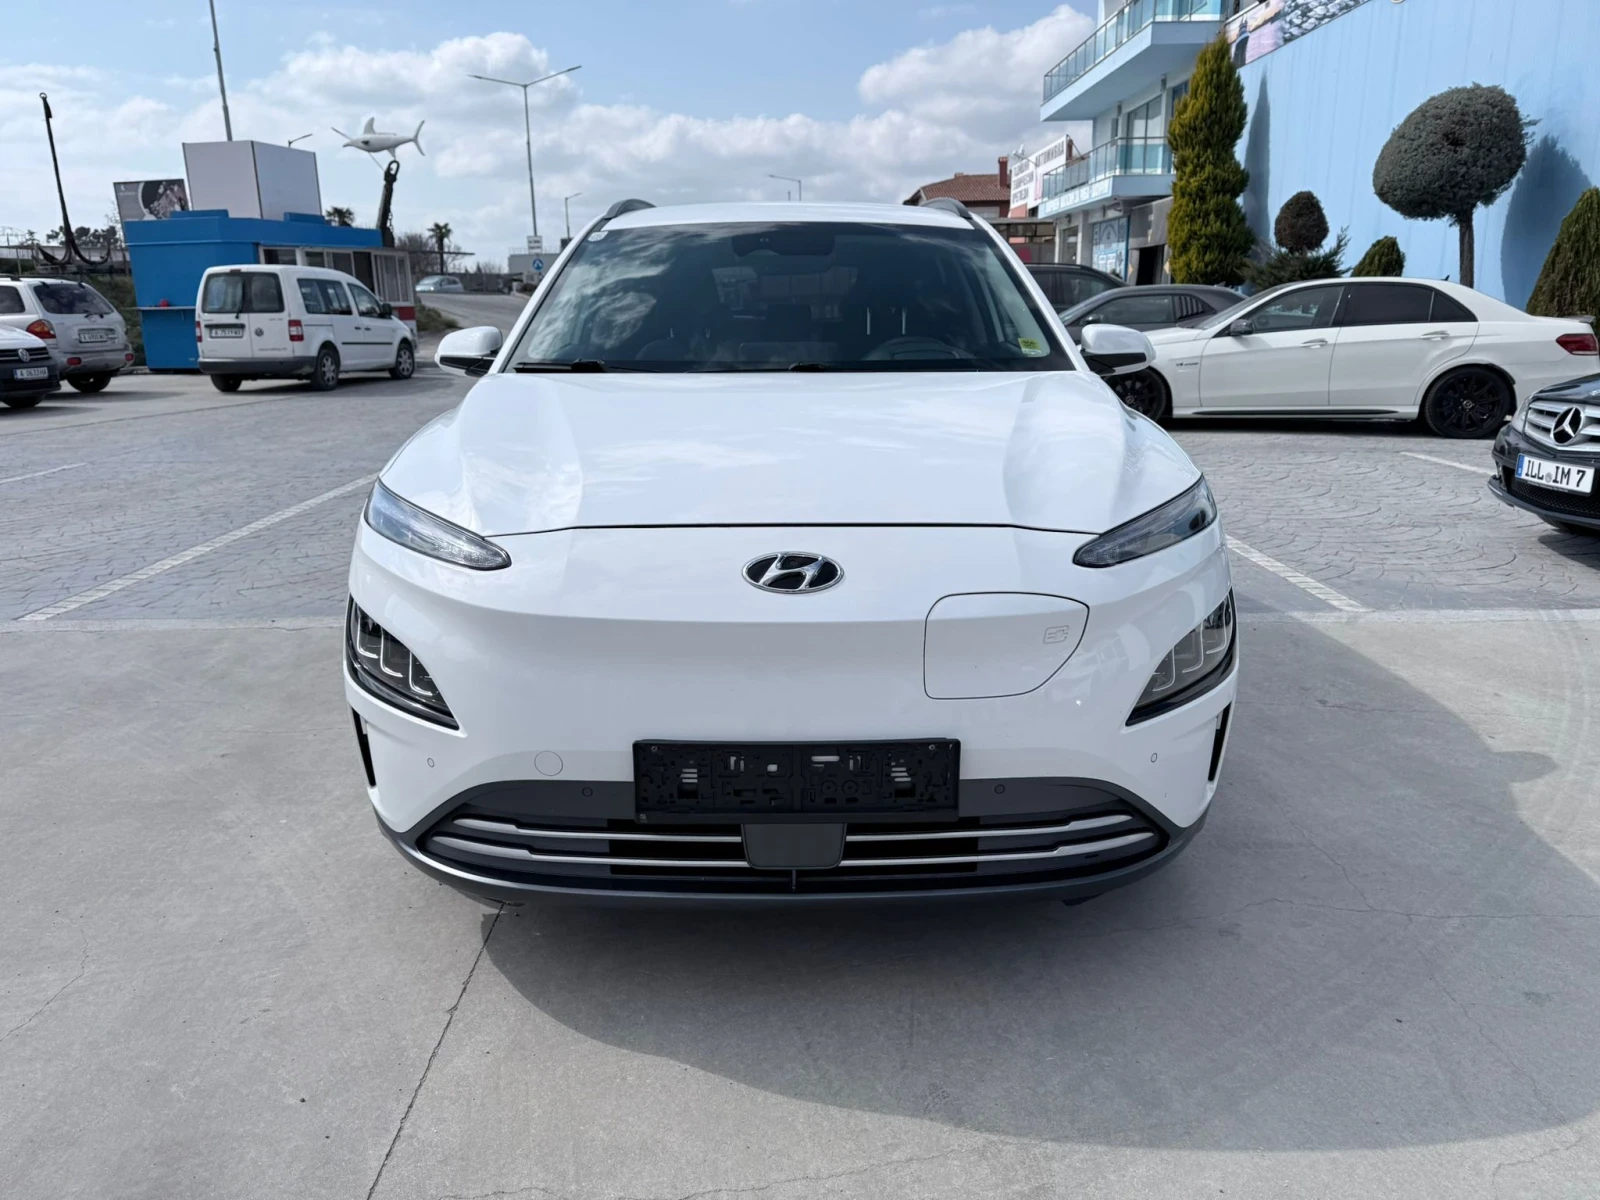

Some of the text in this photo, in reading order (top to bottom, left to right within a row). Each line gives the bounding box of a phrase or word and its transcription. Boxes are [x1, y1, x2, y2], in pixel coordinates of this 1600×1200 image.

[1525, 460, 1544, 480] ILL
[1552, 466, 1571, 486] IM
[1576, 470, 1586, 487] 7
